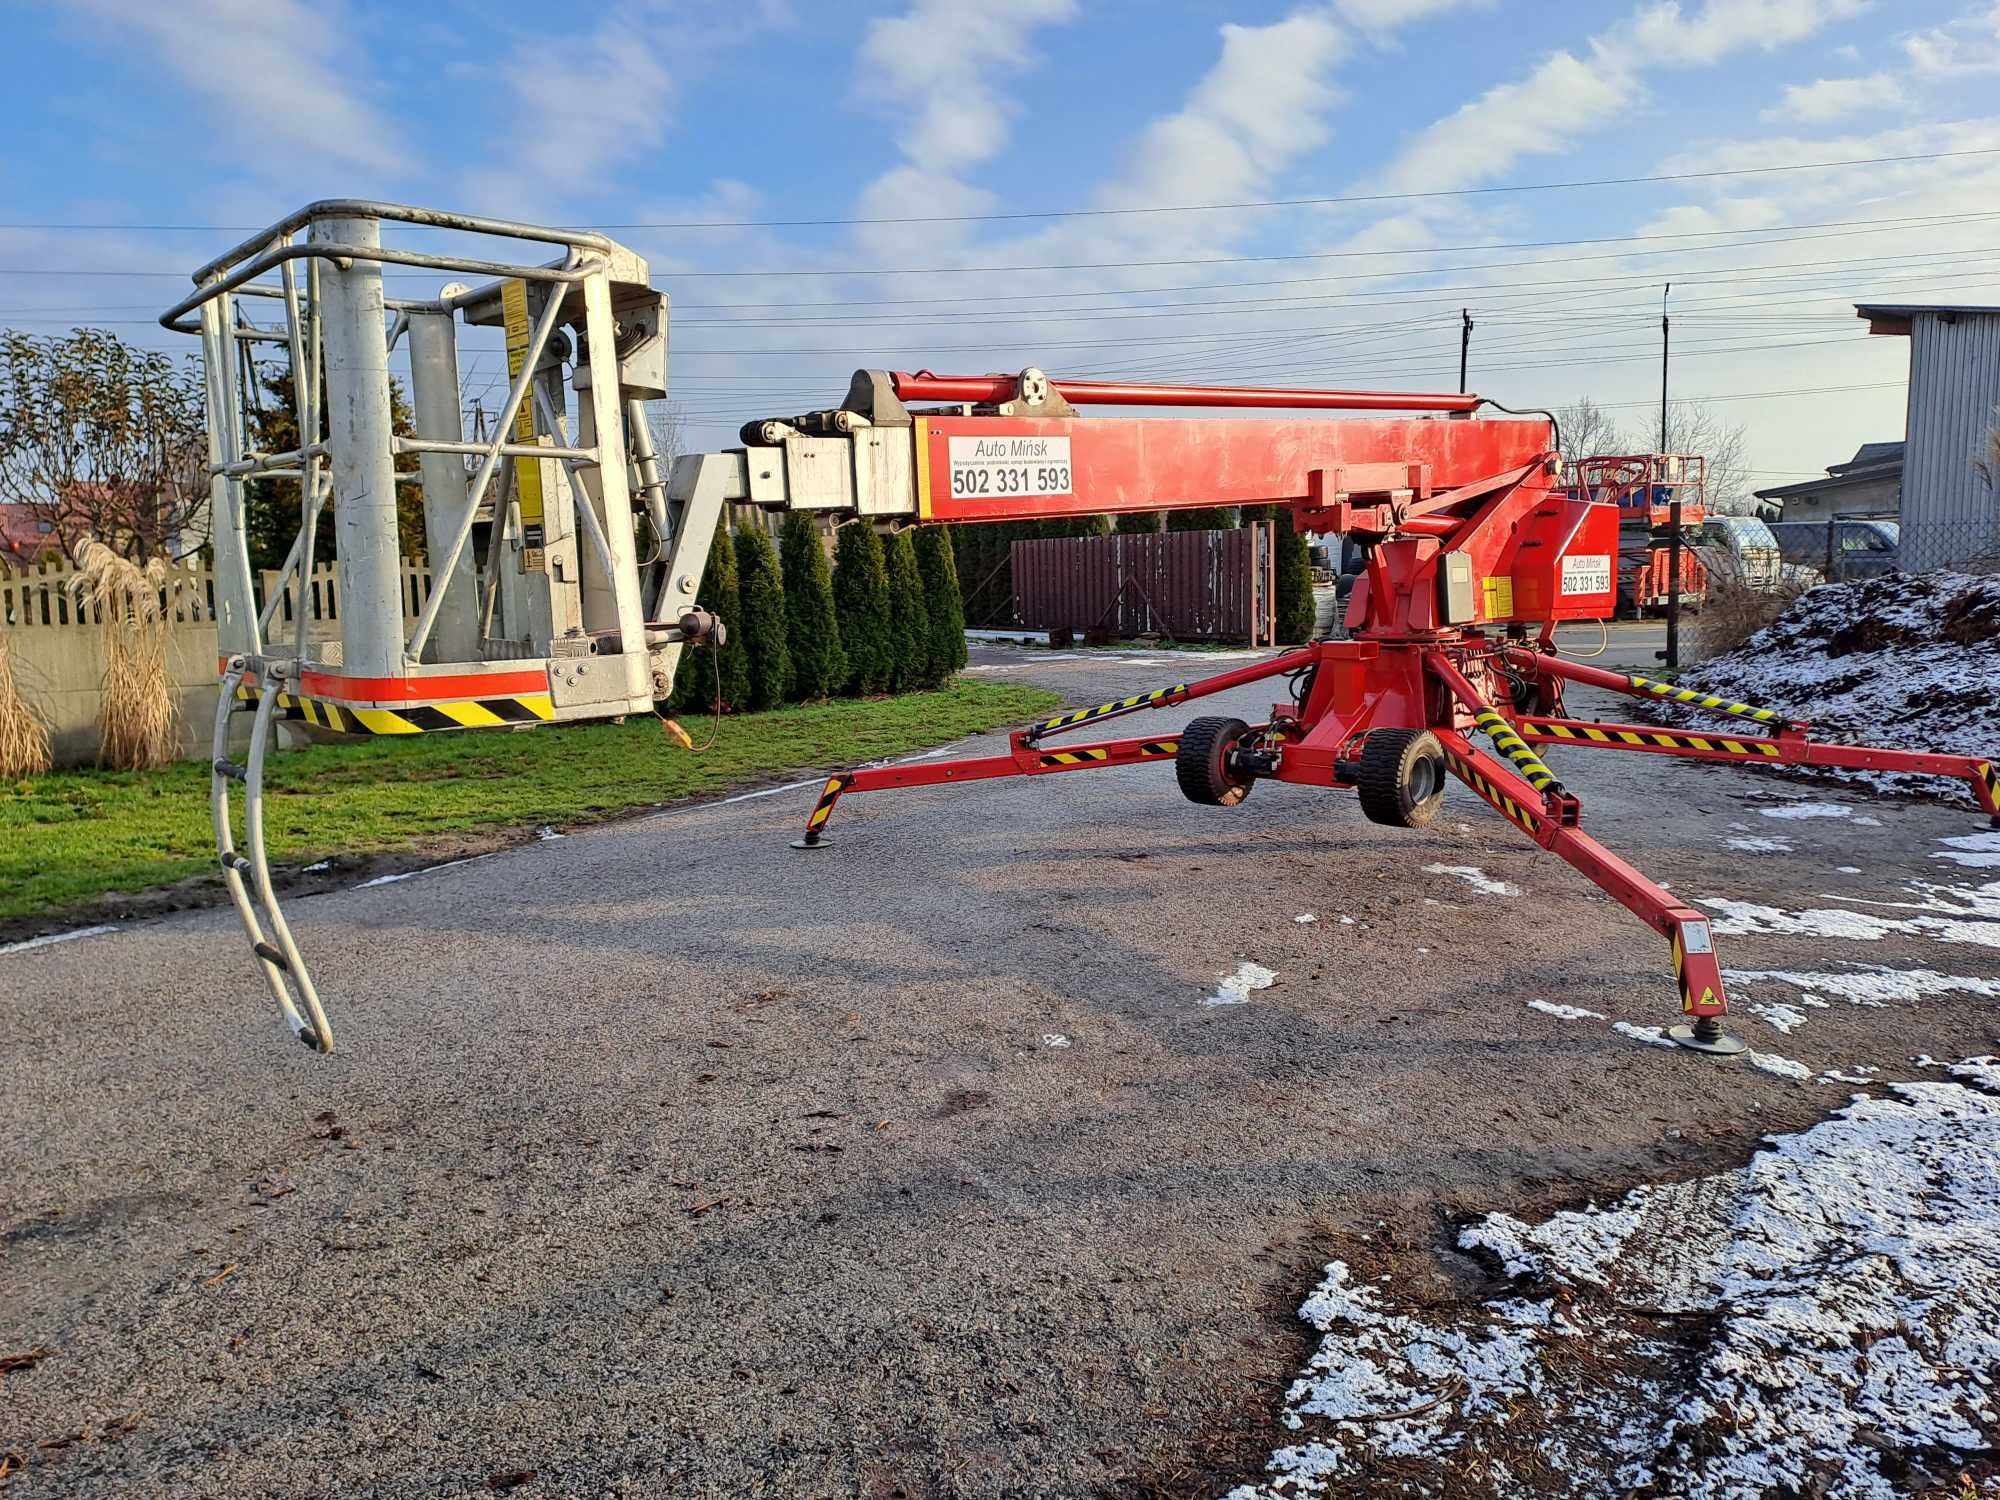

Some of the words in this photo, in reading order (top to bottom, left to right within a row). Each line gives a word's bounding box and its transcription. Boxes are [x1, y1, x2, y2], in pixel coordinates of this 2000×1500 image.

[975, 440, 1006, 457] Auto
[1011, 439, 1048, 457] Mińsk
[953, 469, 989, 494] 502
[996, 468, 1029, 492] 331
[1038, 467, 1070, 491] 593
[1572, 558, 1585, 569] Auto
[1563, 576, 1577, 592] 502
[1580, 576, 1593, 591] 331
[1595, 575, 1609, 591] 593
